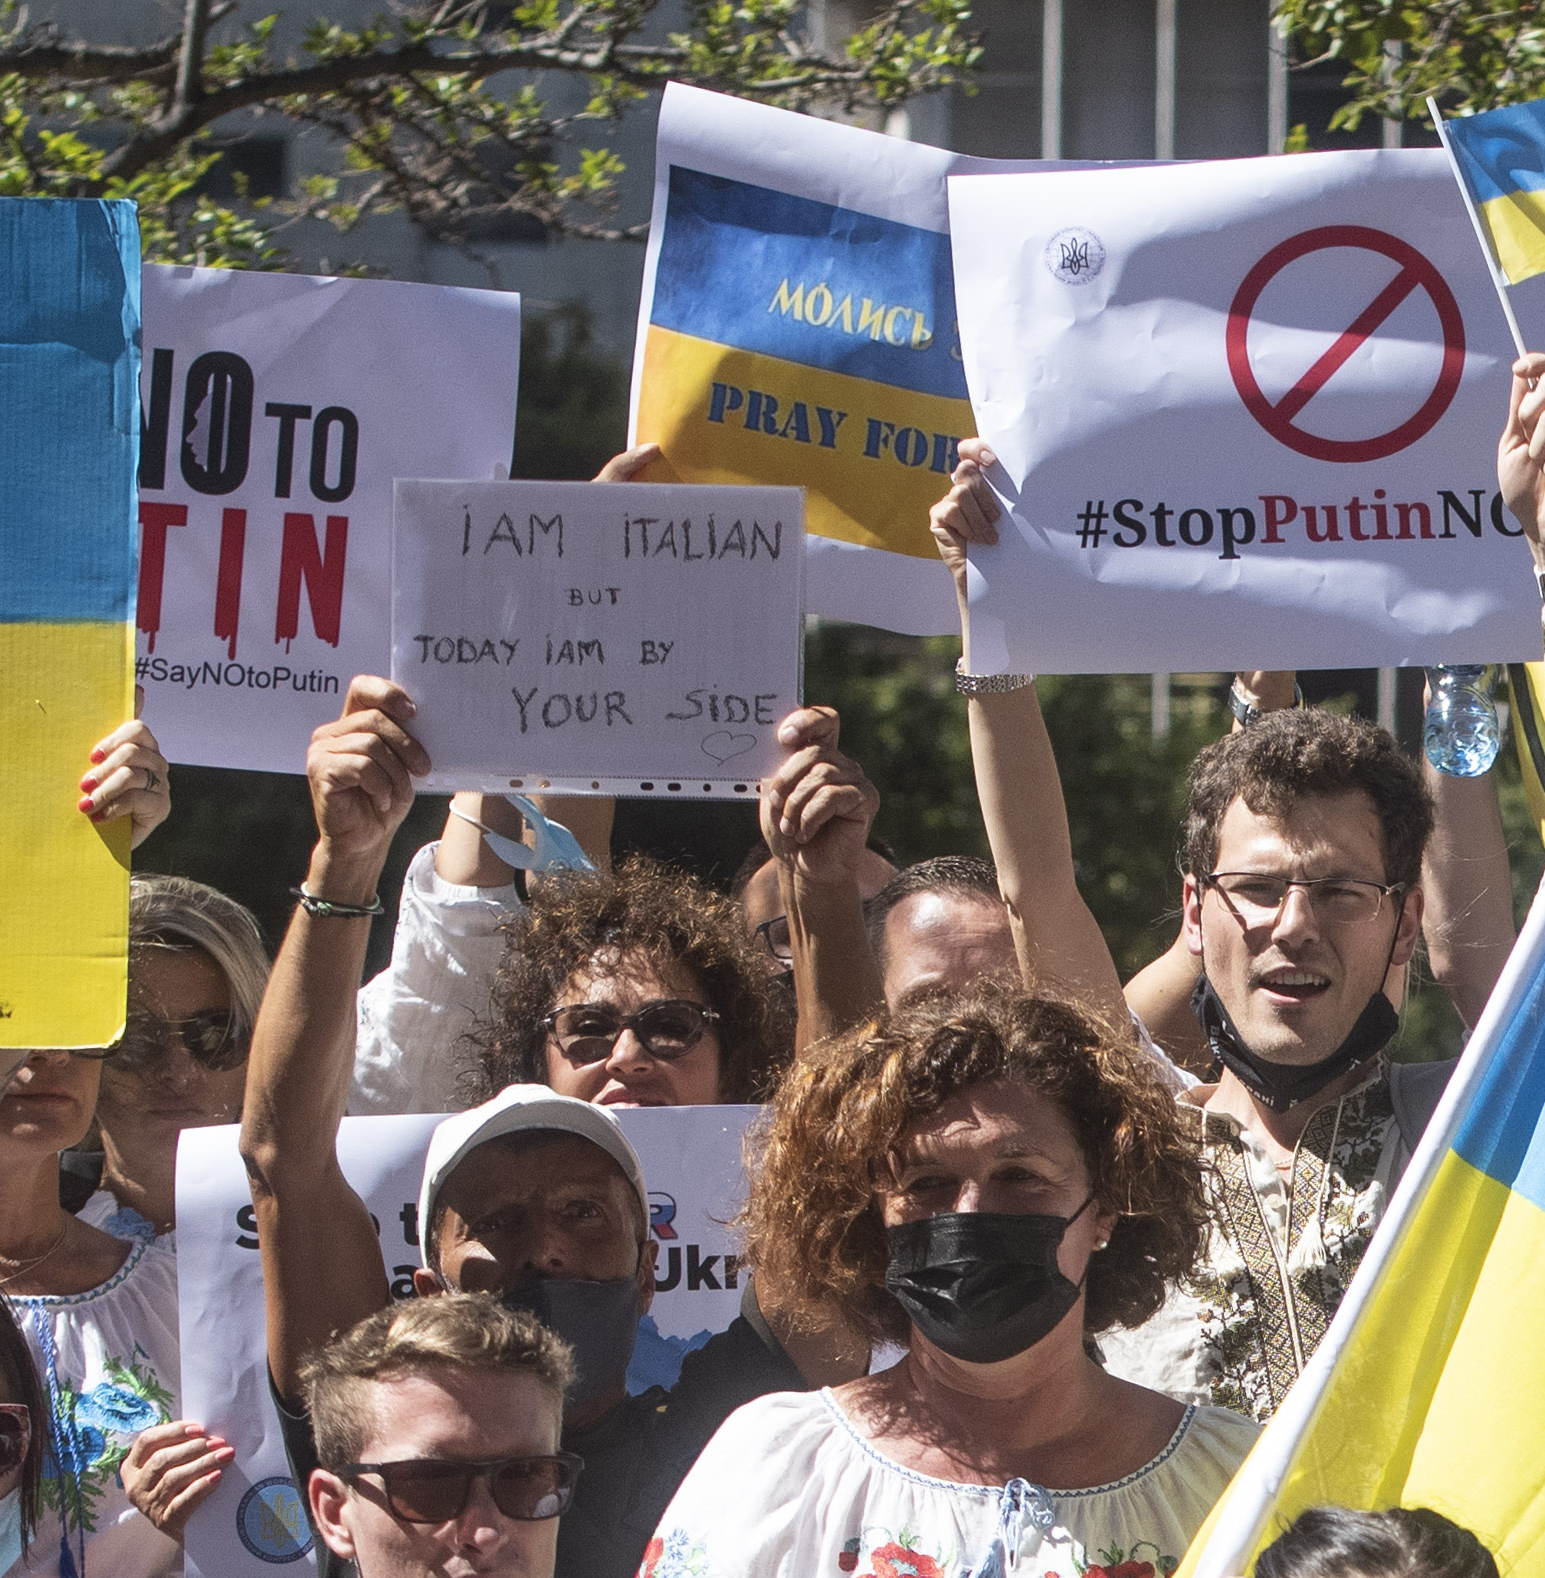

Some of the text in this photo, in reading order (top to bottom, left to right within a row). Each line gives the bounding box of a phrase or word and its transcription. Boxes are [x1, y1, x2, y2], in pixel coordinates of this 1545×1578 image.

[707, 382, 848, 449] PRAY
[265, 402, 359, 503] TO
[566, 587, 622, 606] BUT
[413, 633, 521, 666] TODAY
[639, 640, 674, 666] BY
[135, 656, 339, 694] #SayNOtoPutin
[511, 686, 633, 735] YOUR
